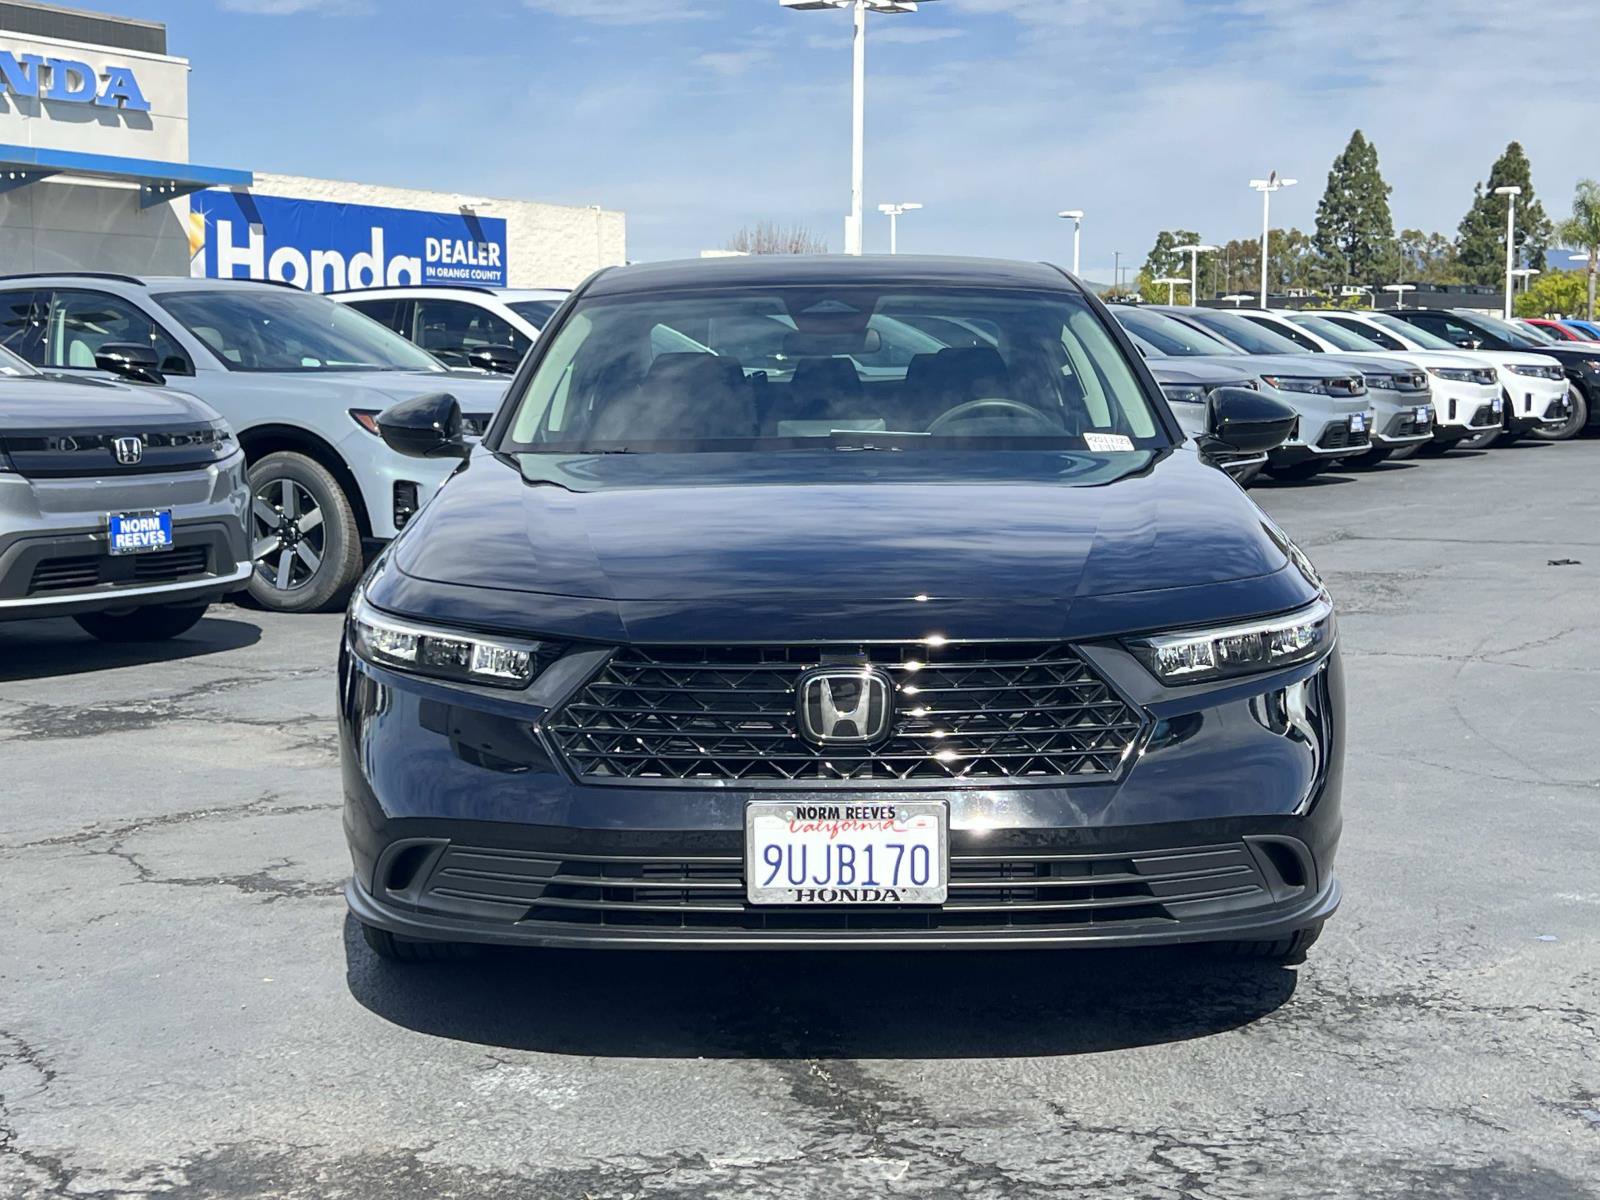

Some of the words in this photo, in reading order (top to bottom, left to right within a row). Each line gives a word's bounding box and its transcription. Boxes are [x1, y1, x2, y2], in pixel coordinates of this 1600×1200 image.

[217, 220, 421, 294] Honda
[425, 237, 501, 267] DEALER
[426, 266, 436, 276] IN
[437, 267, 470, 278] ORANGE
[471, 270, 501, 280] COUNTY
[120, 517, 160, 533] NORM
[115, 530, 166, 547] REEVES
[796, 806, 840, 820] NORM
[846, 806, 896, 820] REEVES
[789, 818, 908, 839] California
[762, 843, 930, 886] 9UJB170
[795, 888, 901, 902] HONDA
